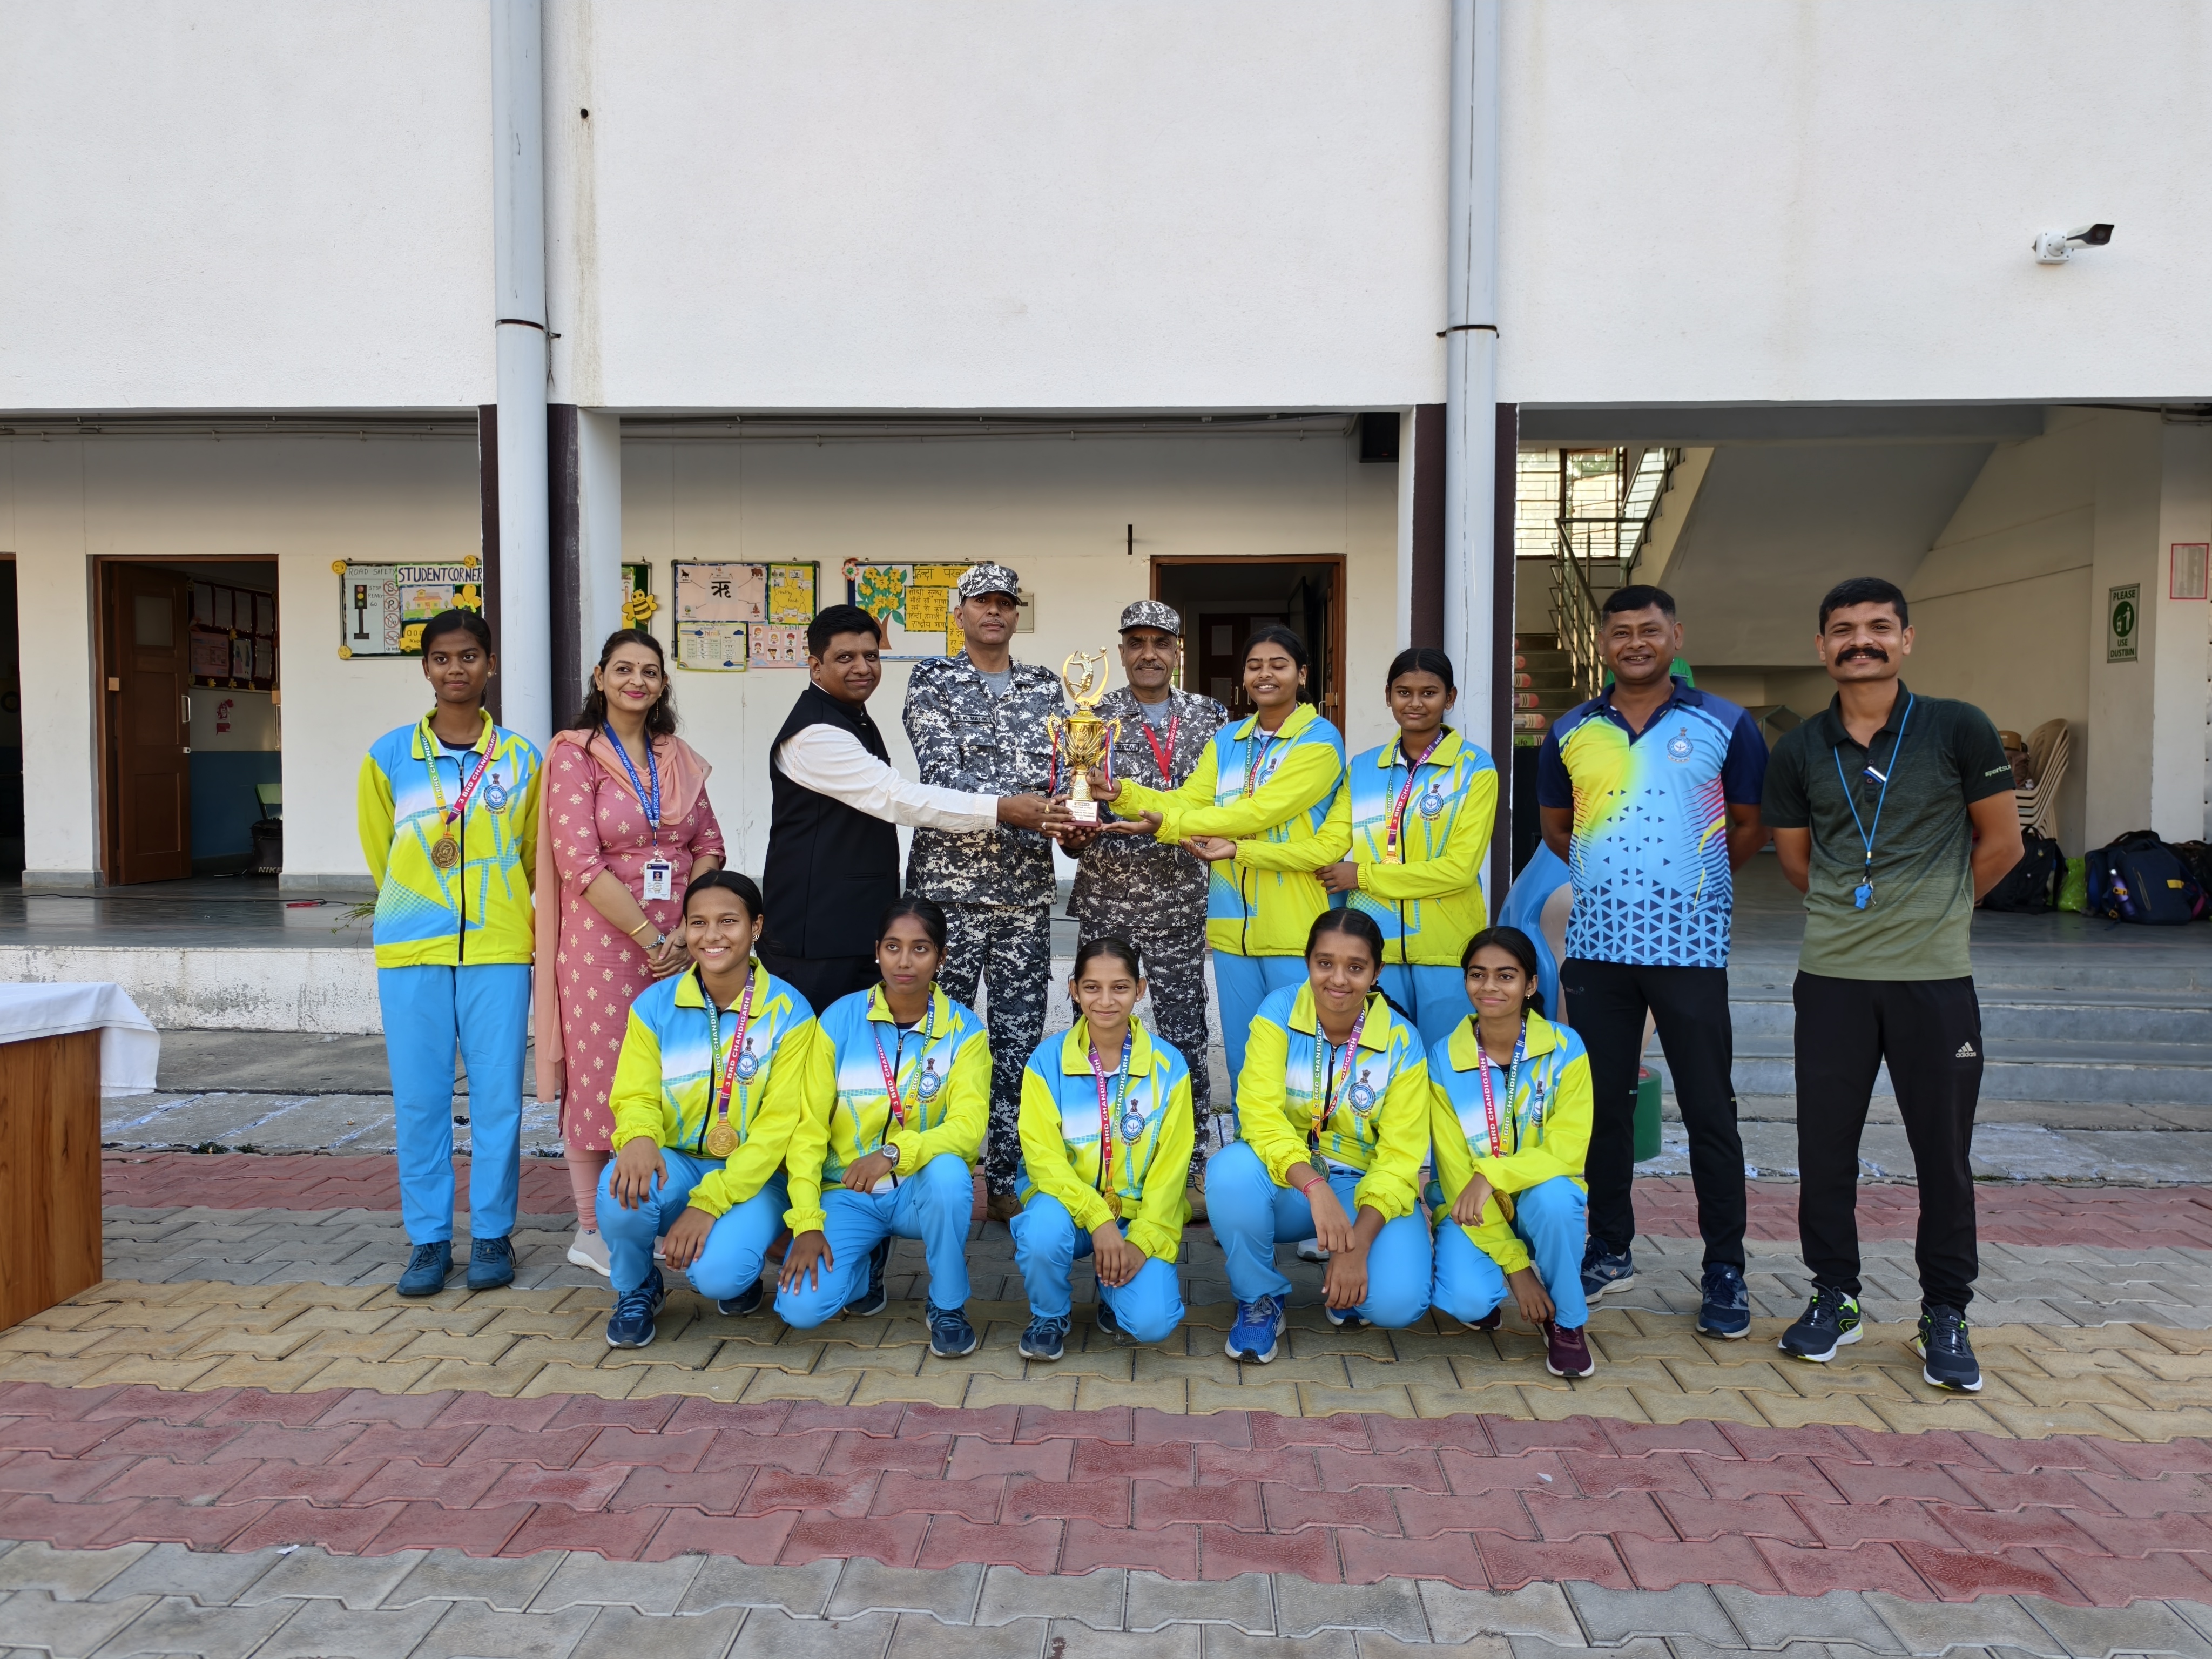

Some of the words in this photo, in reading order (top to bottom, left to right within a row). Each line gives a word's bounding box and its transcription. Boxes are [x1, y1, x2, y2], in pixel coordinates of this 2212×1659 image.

[349, 568, 368, 576] ROAD
[915, 567, 935, 581] हिन्दी
[711, 581, 732, 598] ऋ
[778, 590, 792, 598] Healthy
[2113, 589, 2136, 601] PLEASE
[2117, 638, 2128, 647] USE
[2110, 648, 2135, 658] DUSTBIN
[615, 745, 632, 772] JAMNAGAR
[433, 777, 441, 793] BRD
[631, 770, 643, 791] SCHOOL
[462, 783, 474, 797] BRD
[639, 790, 650, 809] FORCE
[1394, 801, 1402, 817] BRD
[727, 1060, 735, 1080] BRD
[732, 997, 750, 1057] CHANDIGARH
[911, 1071, 920, 1090] BRD
[1116, 1055, 1129, 1116] CHANDIGARH
[1506, 1051, 1520, 1113] CHANDIGARH
[888, 1081, 896, 1098] BRD
[1094, 1059, 1108, 1121] CHANDIGARH
[1481, 1058, 1494, 1121] CHANDIGARH
